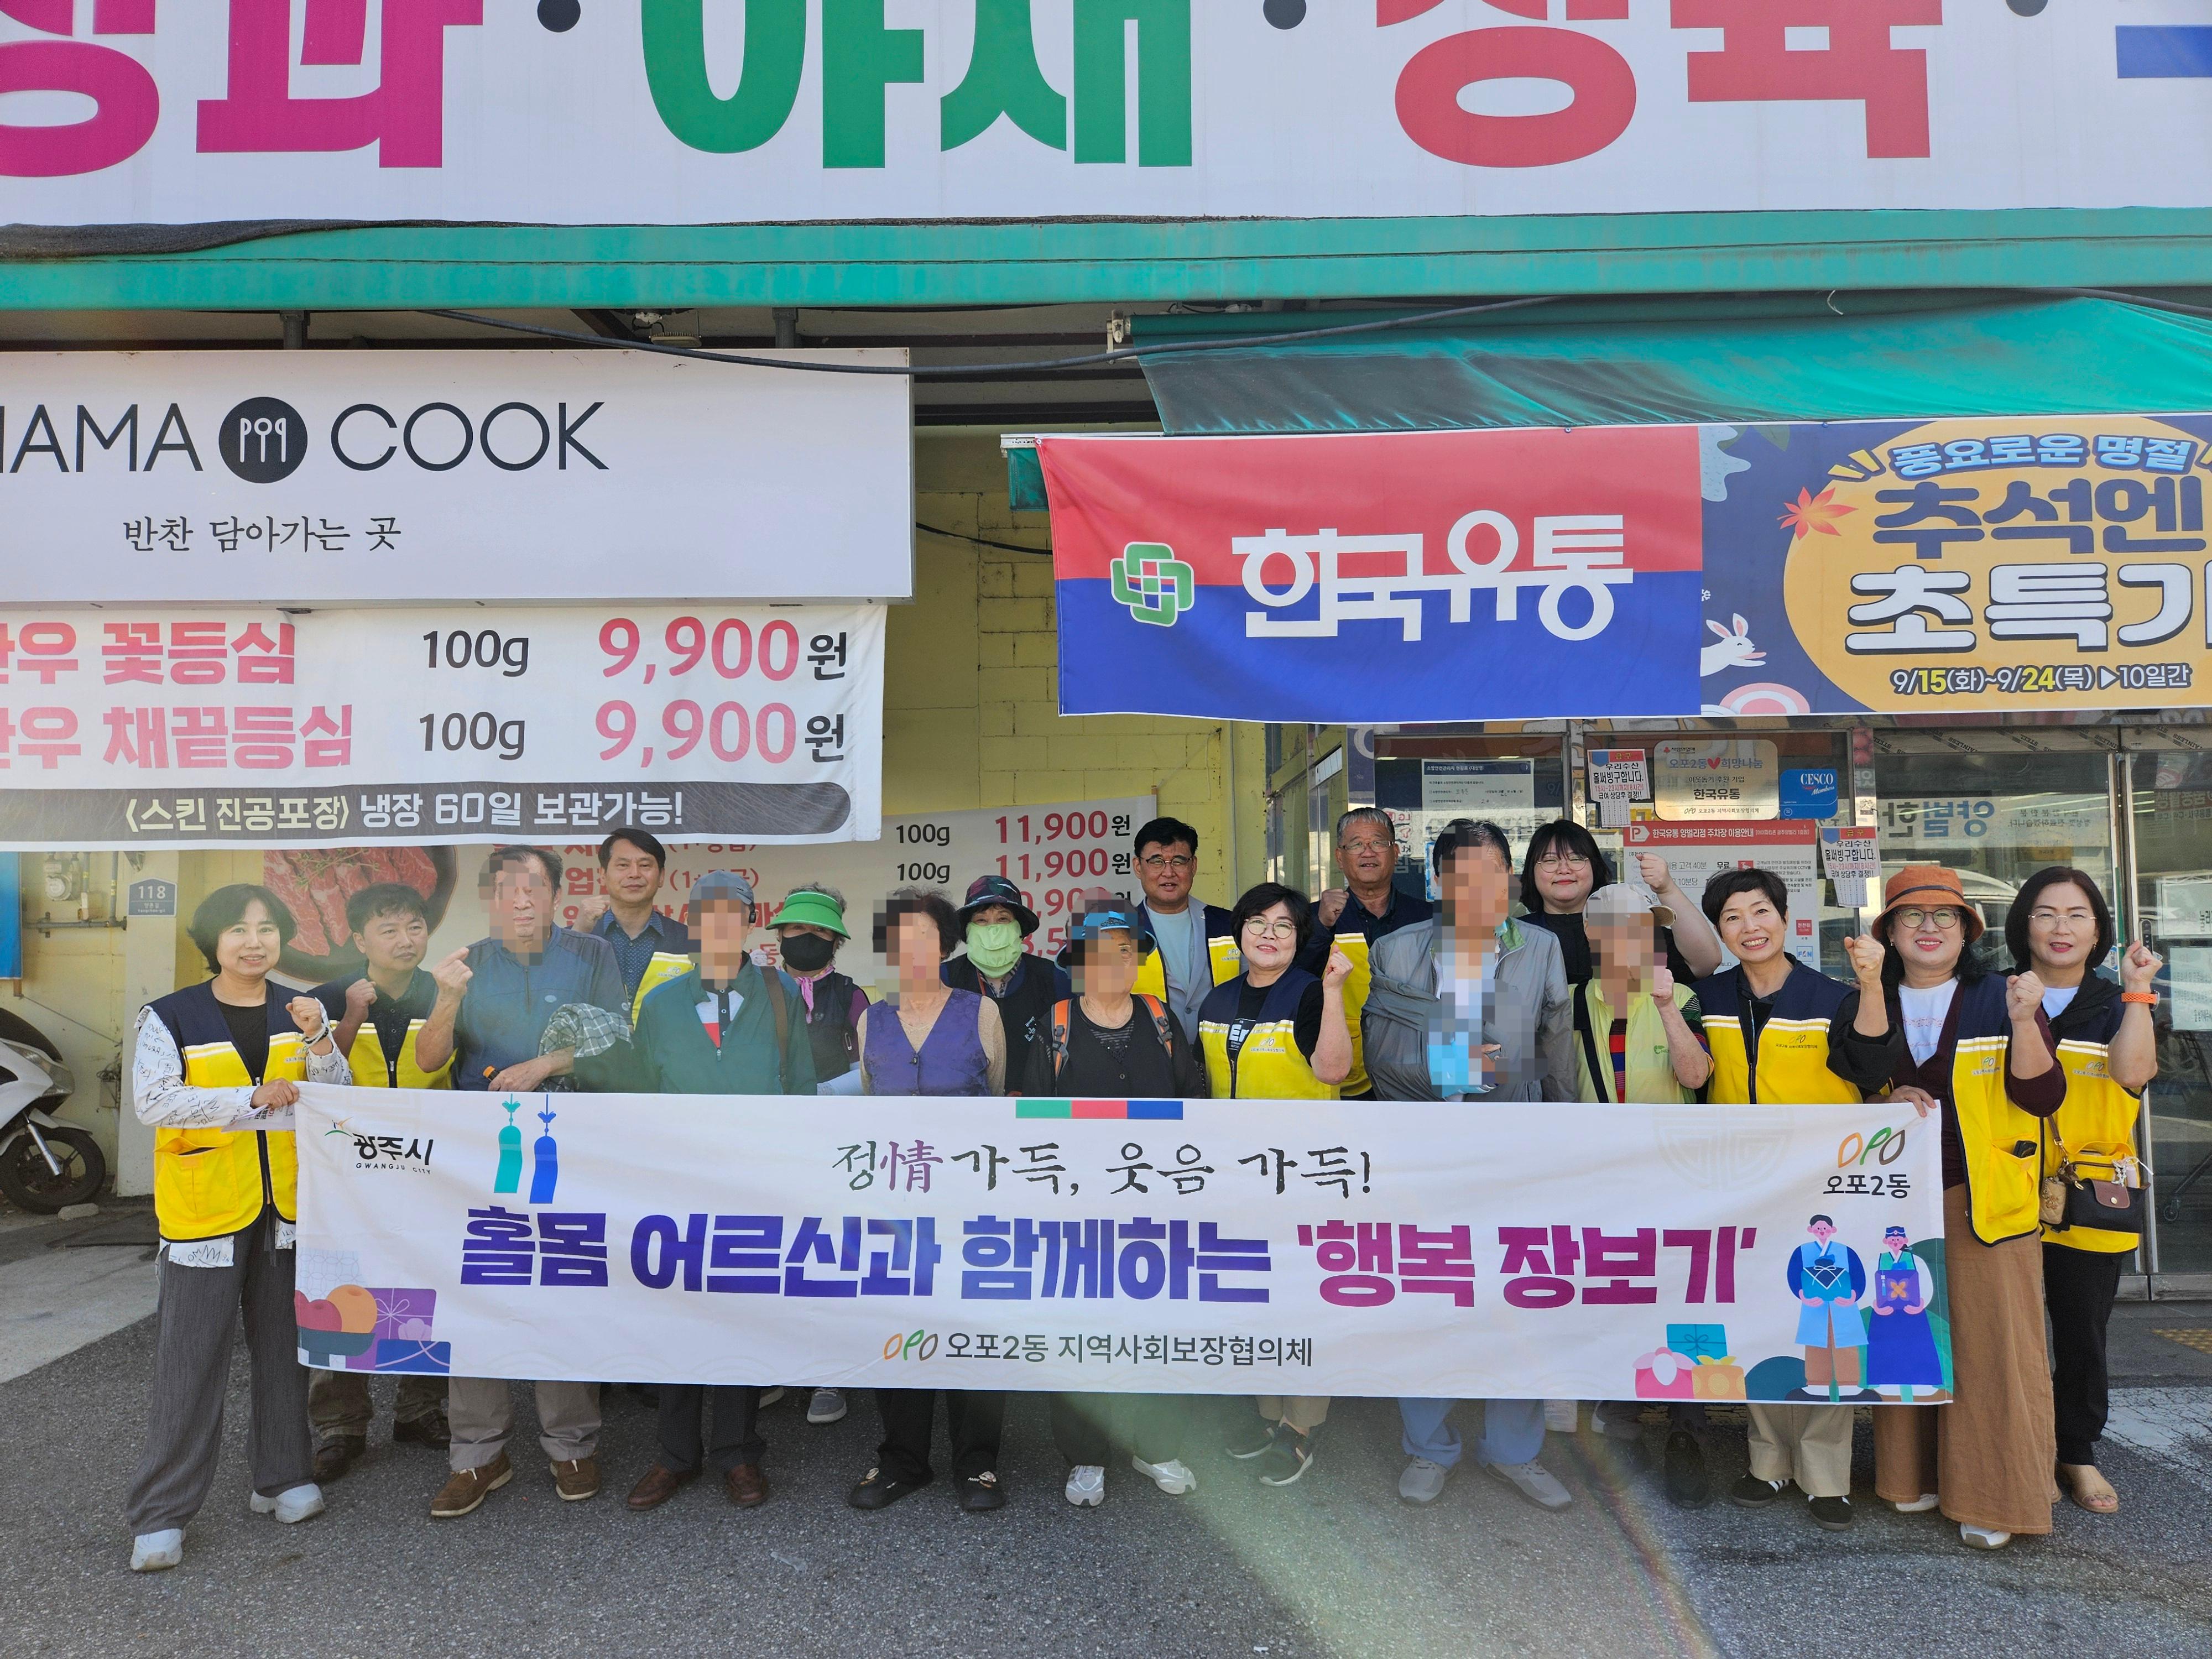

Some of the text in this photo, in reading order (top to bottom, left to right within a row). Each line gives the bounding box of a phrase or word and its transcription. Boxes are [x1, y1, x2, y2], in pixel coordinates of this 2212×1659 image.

[0, 402, 609, 473] AMA COOK
[1892, 434, 2194, 477] 풍요로운 명절
[123, 515, 401, 552] 반찬 담아가는 곳
[1872, 475, 2206, 559] 추석엔
[1232, 510, 1633, 641] 한국유통
[101, 623, 295, 684] 꽃등심
[423, 630, 529, 677] 100g
[103, 705, 352, 769] 채끝등심
[419, 712, 525, 760] 100g
[1670, 758, 1764, 769] 오포2동 희망나눔
[1800, 773, 1834, 785] CESCO
[361, 792, 422, 828] 냉장
[436, 792, 521, 826] 60일
[534, 792, 682, 825] 보관가능!
[1693, 788, 1740, 800] 한국유통
[896, 824, 950, 846] 100g
[1652, 829, 1679, 838] 한국유통
[1680, 829, 1706, 838] 양벌리점
[1707, 829, 1727, 838] 주차장
[1728, 828, 1754, 837] 이용안내
[897, 863, 950, 884] 100g
[1679, 862, 1692, 870] 고객
[138, 885, 165, 899] 118
[353, 1133, 434, 1166] 광주시
[951, 1142, 1079, 1196] 가득,
[1106, 1142, 1215, 1196] 웃음
[1238, 1146, 1371, 1199] 가득!
[1823, 1174, 1911, 1199] 오포2동
[461, 1205, 608, 1287] 홀몸
[630, 1213, 941, 1298] 어르신과
[962, 1215, 1271, 1303] 함께하는
[946, 1333, 1049, 1363] 오포2동
[1058, 1334, 1312, 1368] 지역사회보장협의체
